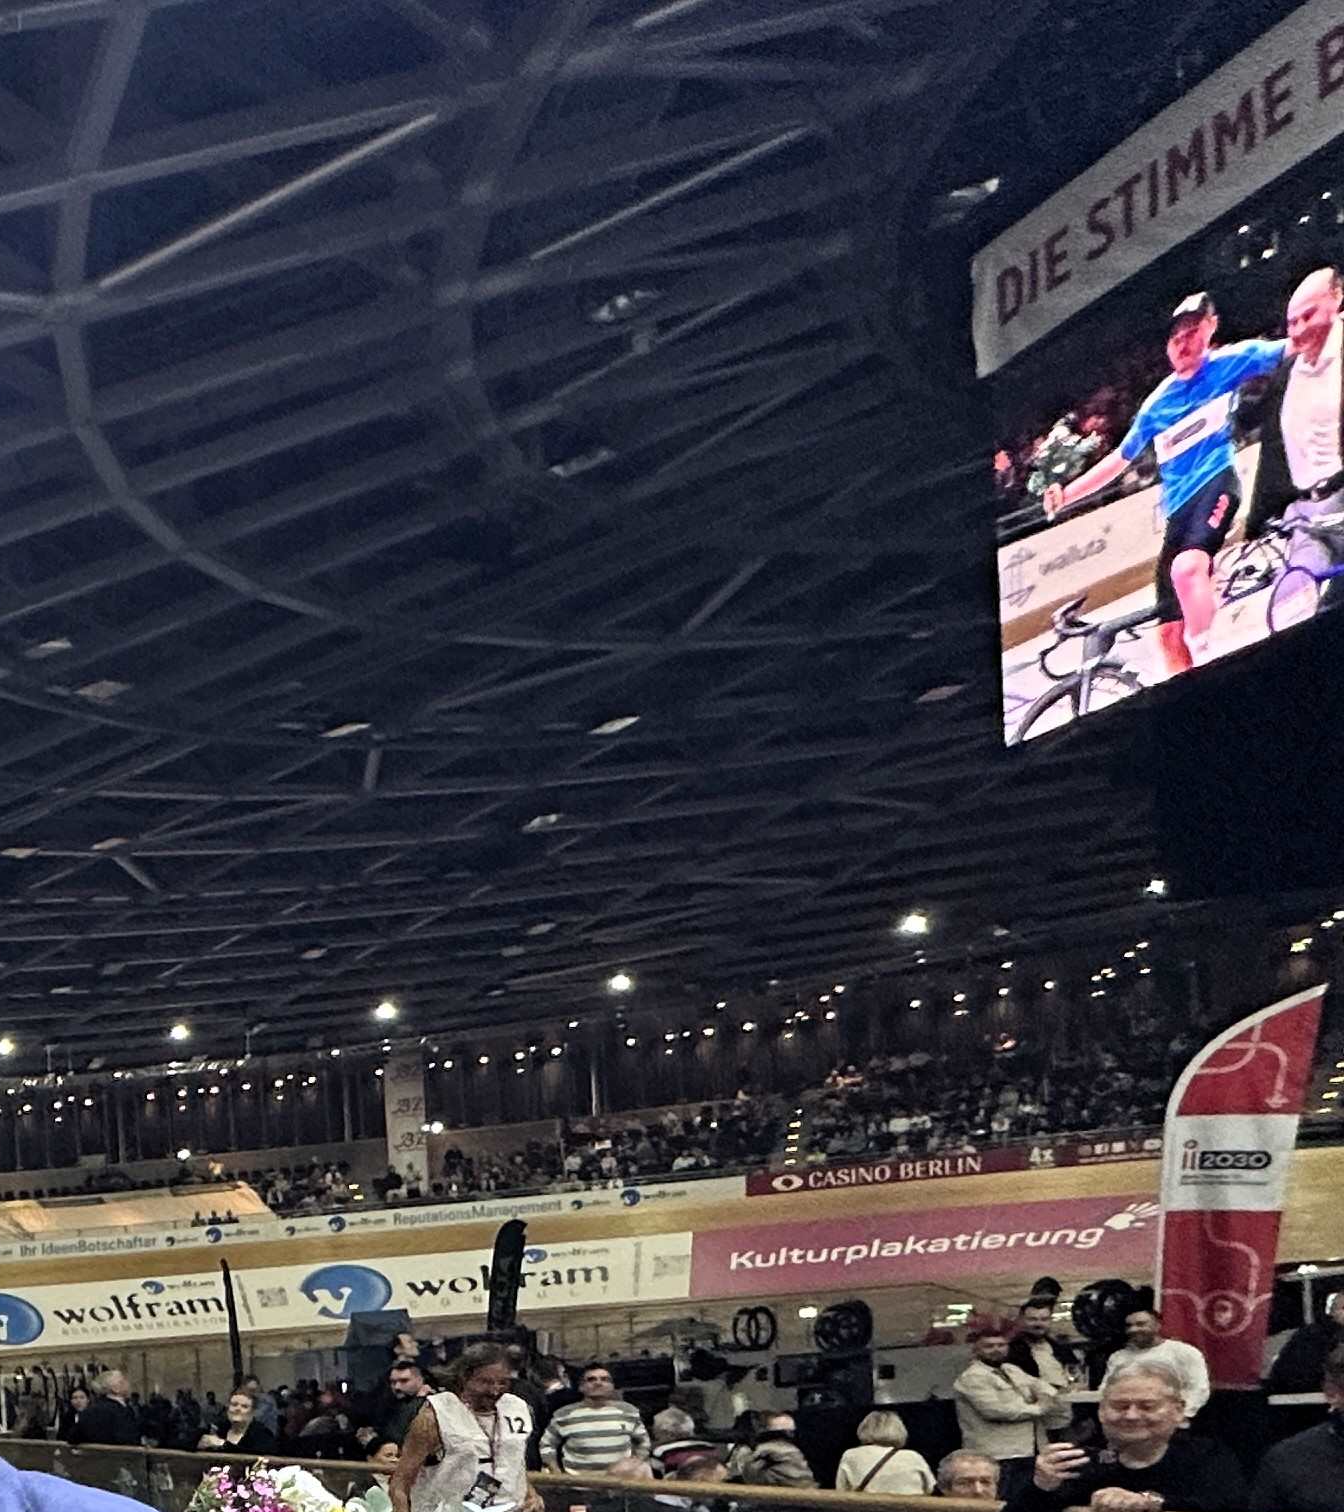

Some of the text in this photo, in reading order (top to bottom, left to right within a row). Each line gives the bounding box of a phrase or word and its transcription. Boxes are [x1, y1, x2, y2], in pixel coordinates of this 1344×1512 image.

[996, 225, 1072, 326] DIE
[1086, 60, 1296, 262] STIMME
[808, 1156, 982, 1189] CASINO BERLIN
[393, 1199, 563, 1226] ReputationsManagement
[19, 1236, 157, 1258] Ihr IdeenBotschafter
[729, 1227, 1105, 1271] Kulturplakatierung
[406, 1264, 610, 1296] wolram
[53, 1292, 225, 1326] wolfram
[503, 1416, 528, 1434] 12
